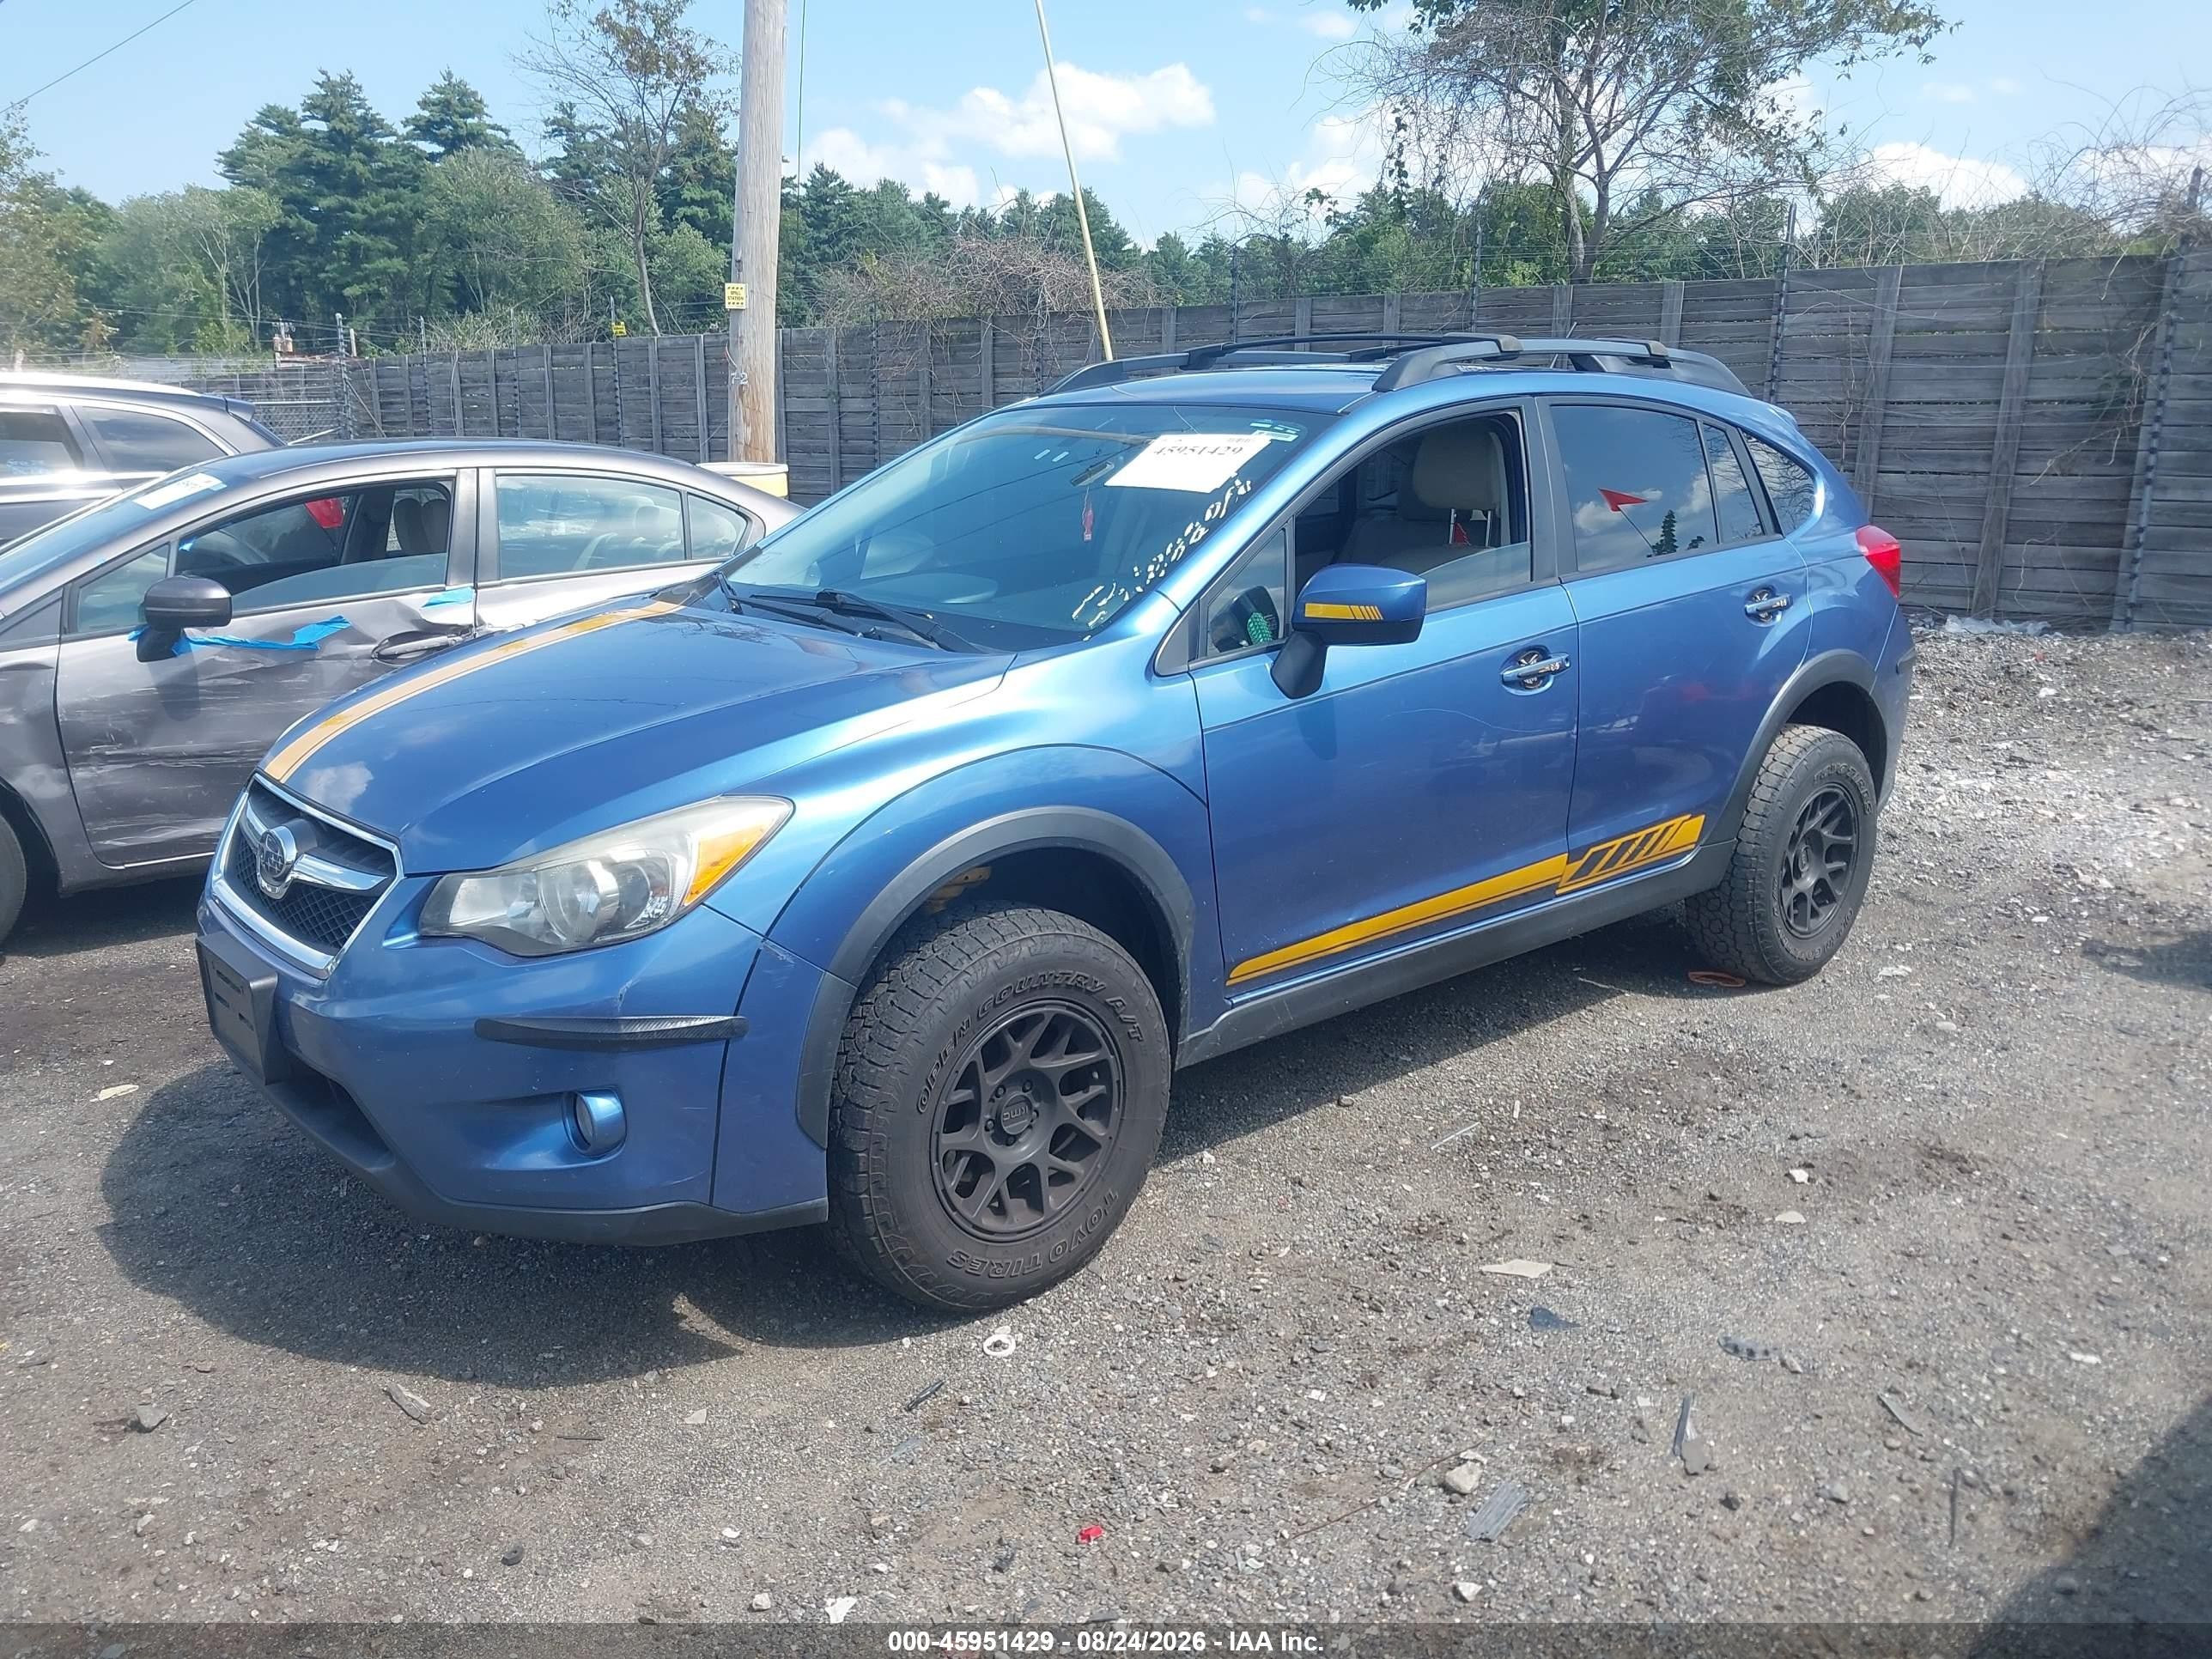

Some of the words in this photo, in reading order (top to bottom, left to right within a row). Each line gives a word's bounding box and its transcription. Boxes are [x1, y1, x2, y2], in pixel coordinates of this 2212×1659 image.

[1153, 446, 1243, 456] 45951429
[916, 1018, 971, 1115] OPEN
[977, 969, 1108, 1016] COUNTRY
[1105, 996, 1145, 1043] A/T
[1048, 1189, 1119, 1265] TOYO
[945, 1248, 1042, 1279] TIRES
